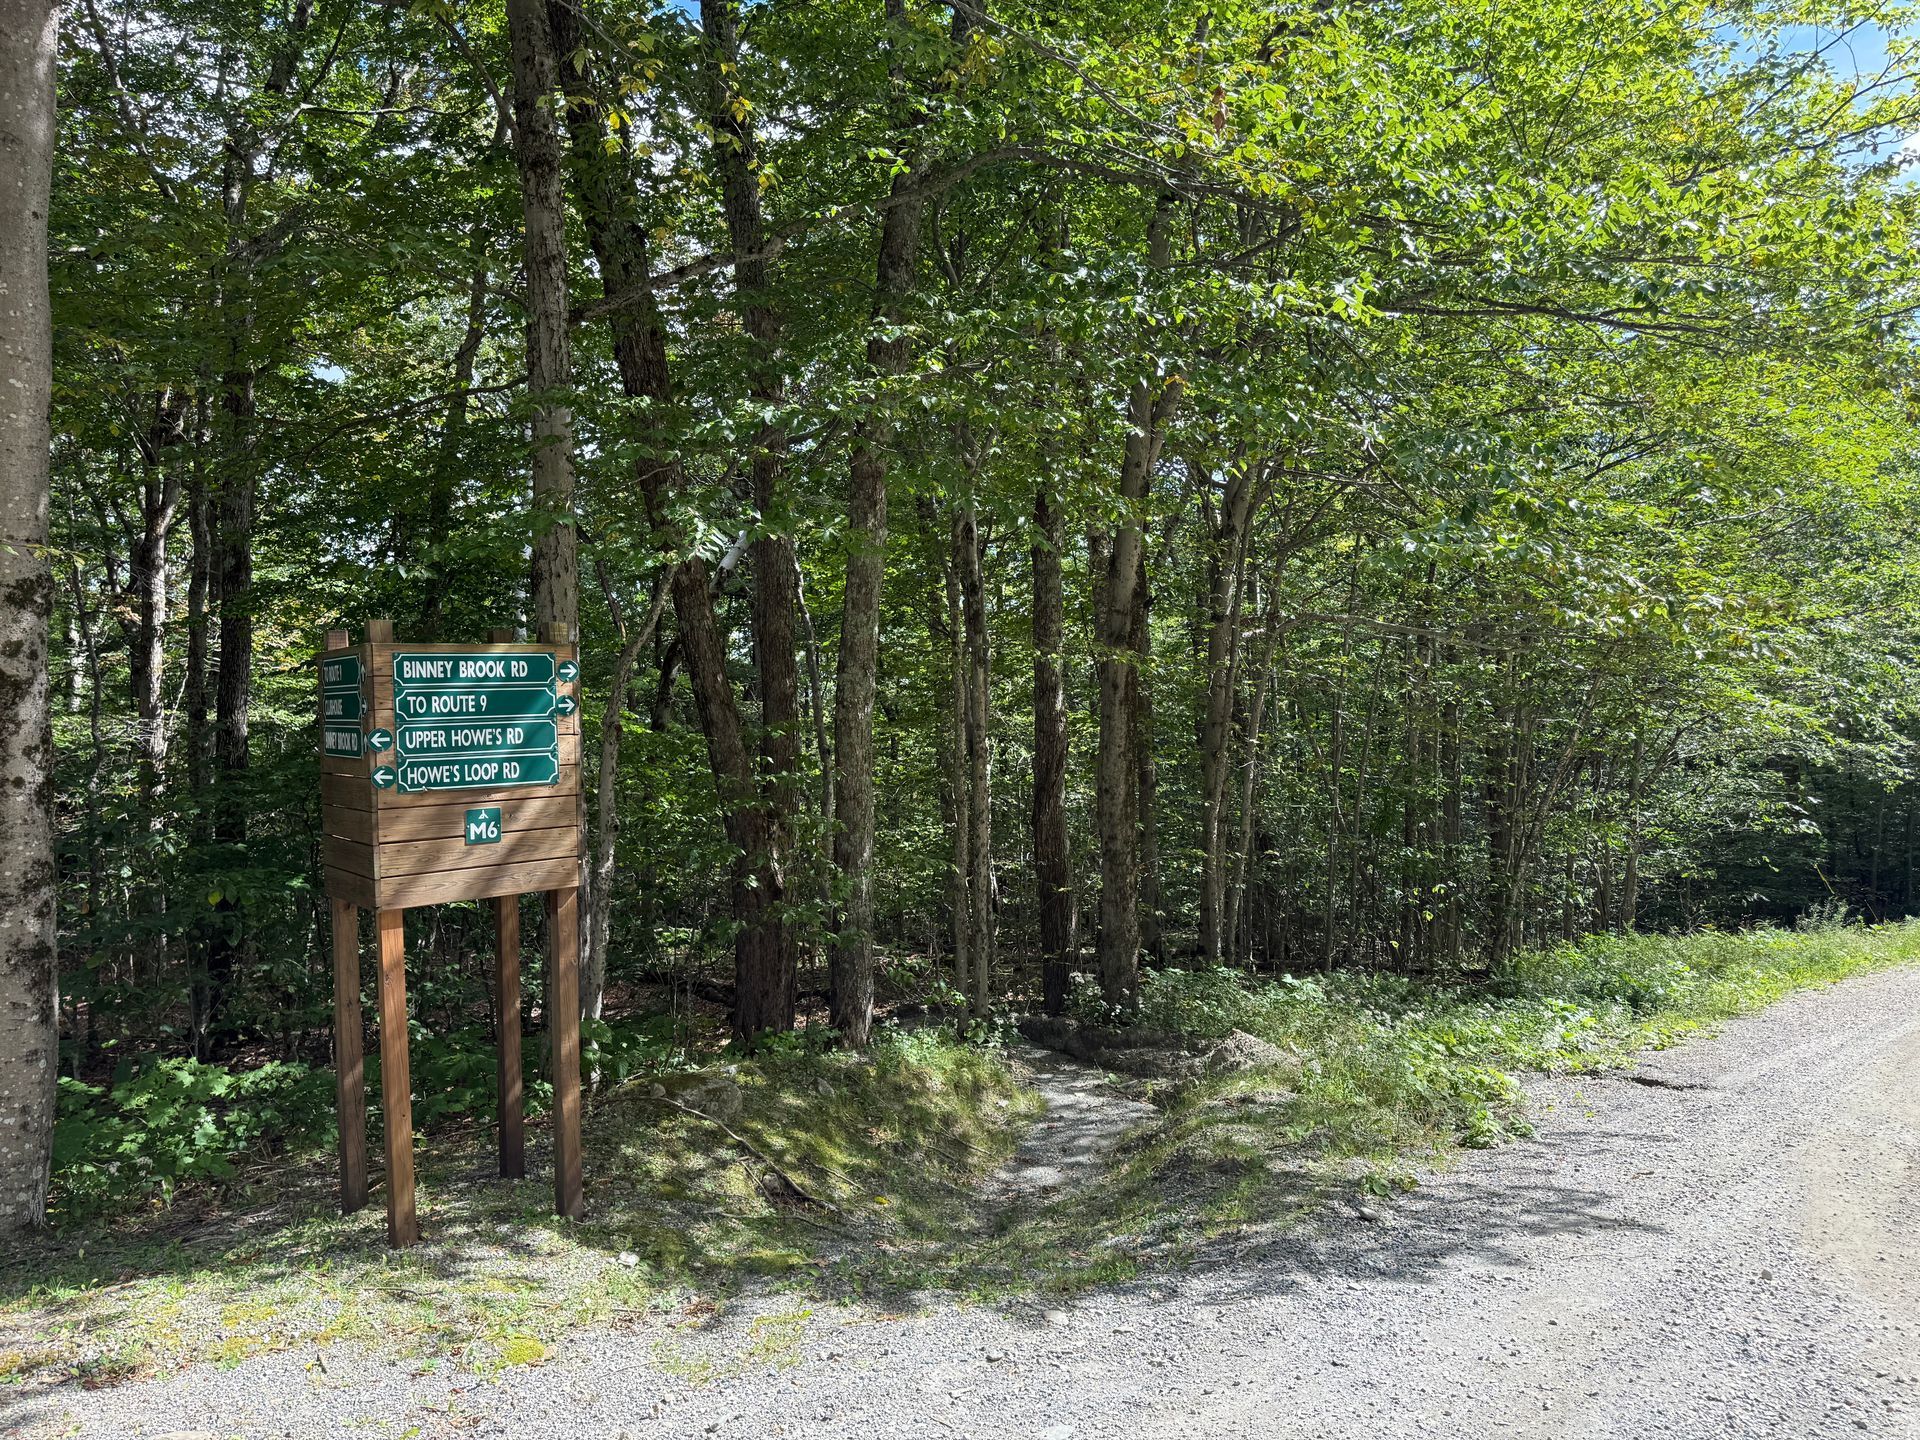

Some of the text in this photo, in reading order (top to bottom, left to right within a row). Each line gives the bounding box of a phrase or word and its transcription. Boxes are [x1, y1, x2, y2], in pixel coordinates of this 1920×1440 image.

[403, 660, 528, 679] BINNEY BROOK RD
[407, 695, 487, 714] TO ROUTE 9
[325, 731, 358, 751] BINNEY BROOK RD
[405, 727, 524, 749] UPPER HOWE'S RD
[407, 762, 520, 784] HOWE'S LOOP RD
[470, 821, 498, 840] M6
